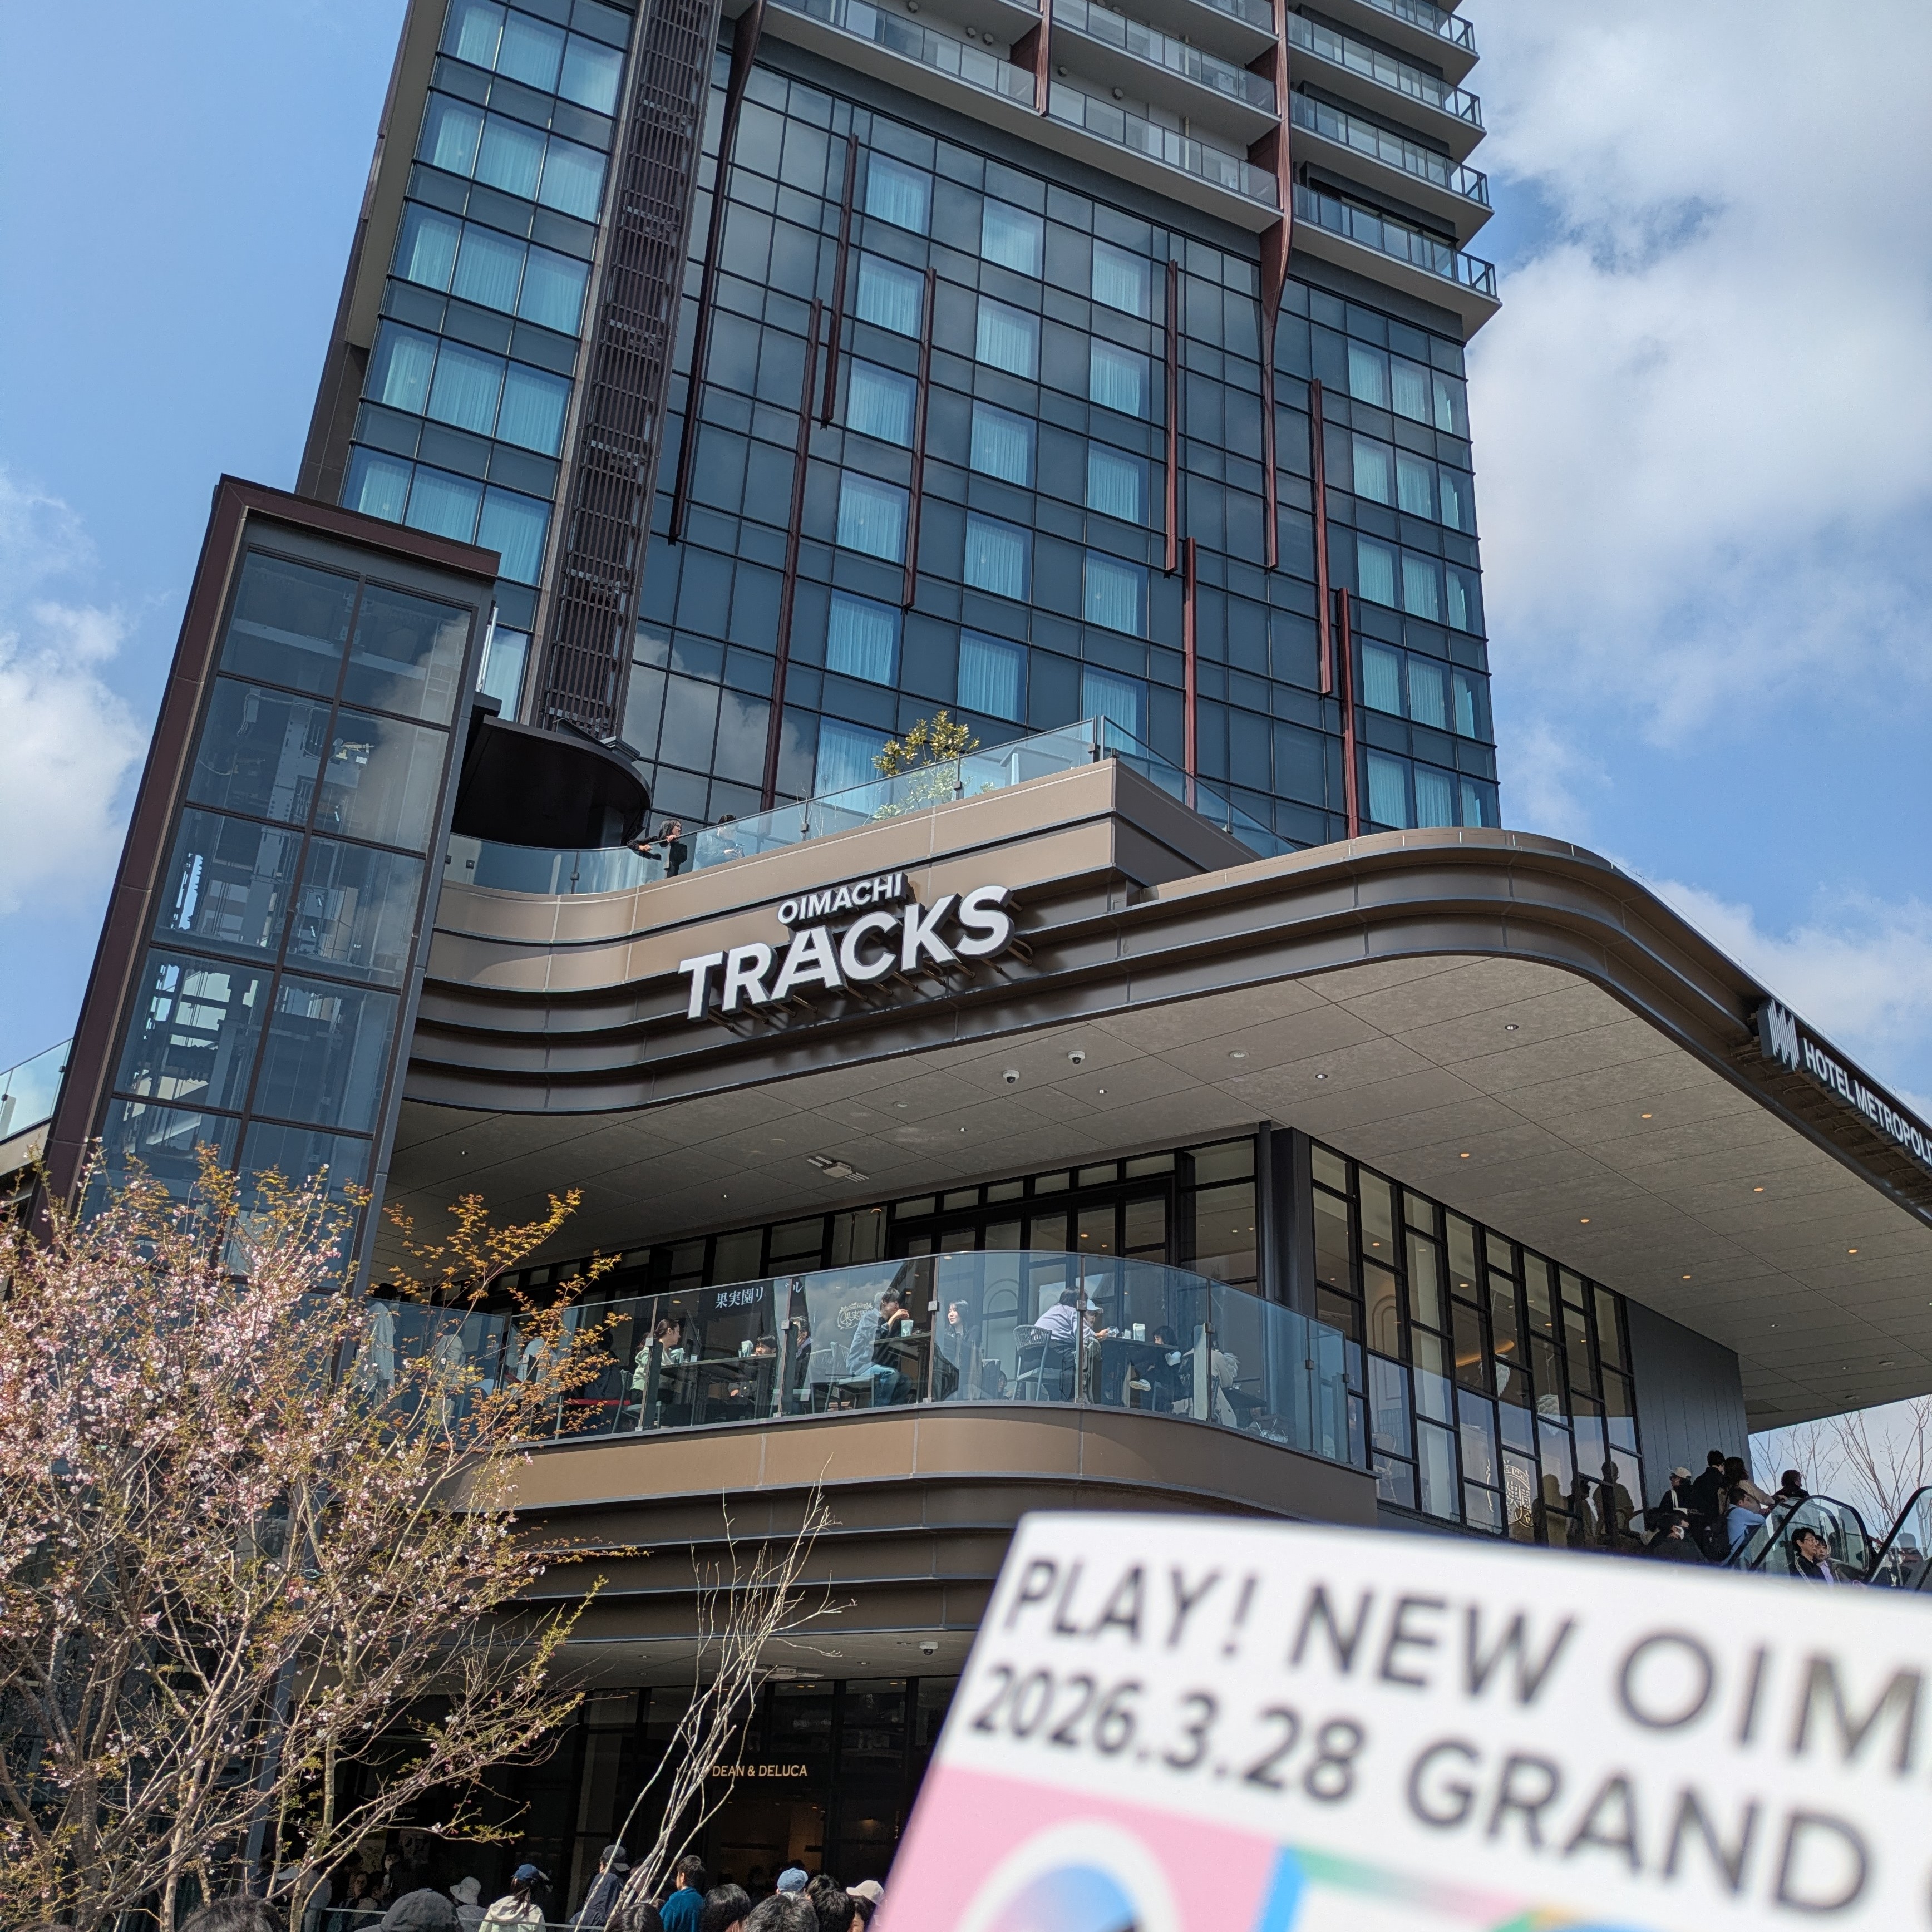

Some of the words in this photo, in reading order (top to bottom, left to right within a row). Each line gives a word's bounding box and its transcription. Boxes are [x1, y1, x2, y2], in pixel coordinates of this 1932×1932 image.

[678, 885, 1014, 1021] TRACKS
[777, 872, 904, 924] OIMACHI
[1803, 1038, 1855, 1105] HOTEL
[1854, 1080, 1932, 1167] METROPOLI
[1004, 1556, 1258, 1657] PLAY!
[1288, 1581, 1578, 1709] NEW
[712, 1765, 745, 1777] DEAN
[747, 1765, 756, 1777] &
[758, 1765, 808, 1777] DELUCA
[969, 1663, 1368, 1807] 2026.3.28
[1404, 1737, 1875, 1919] GRAND
